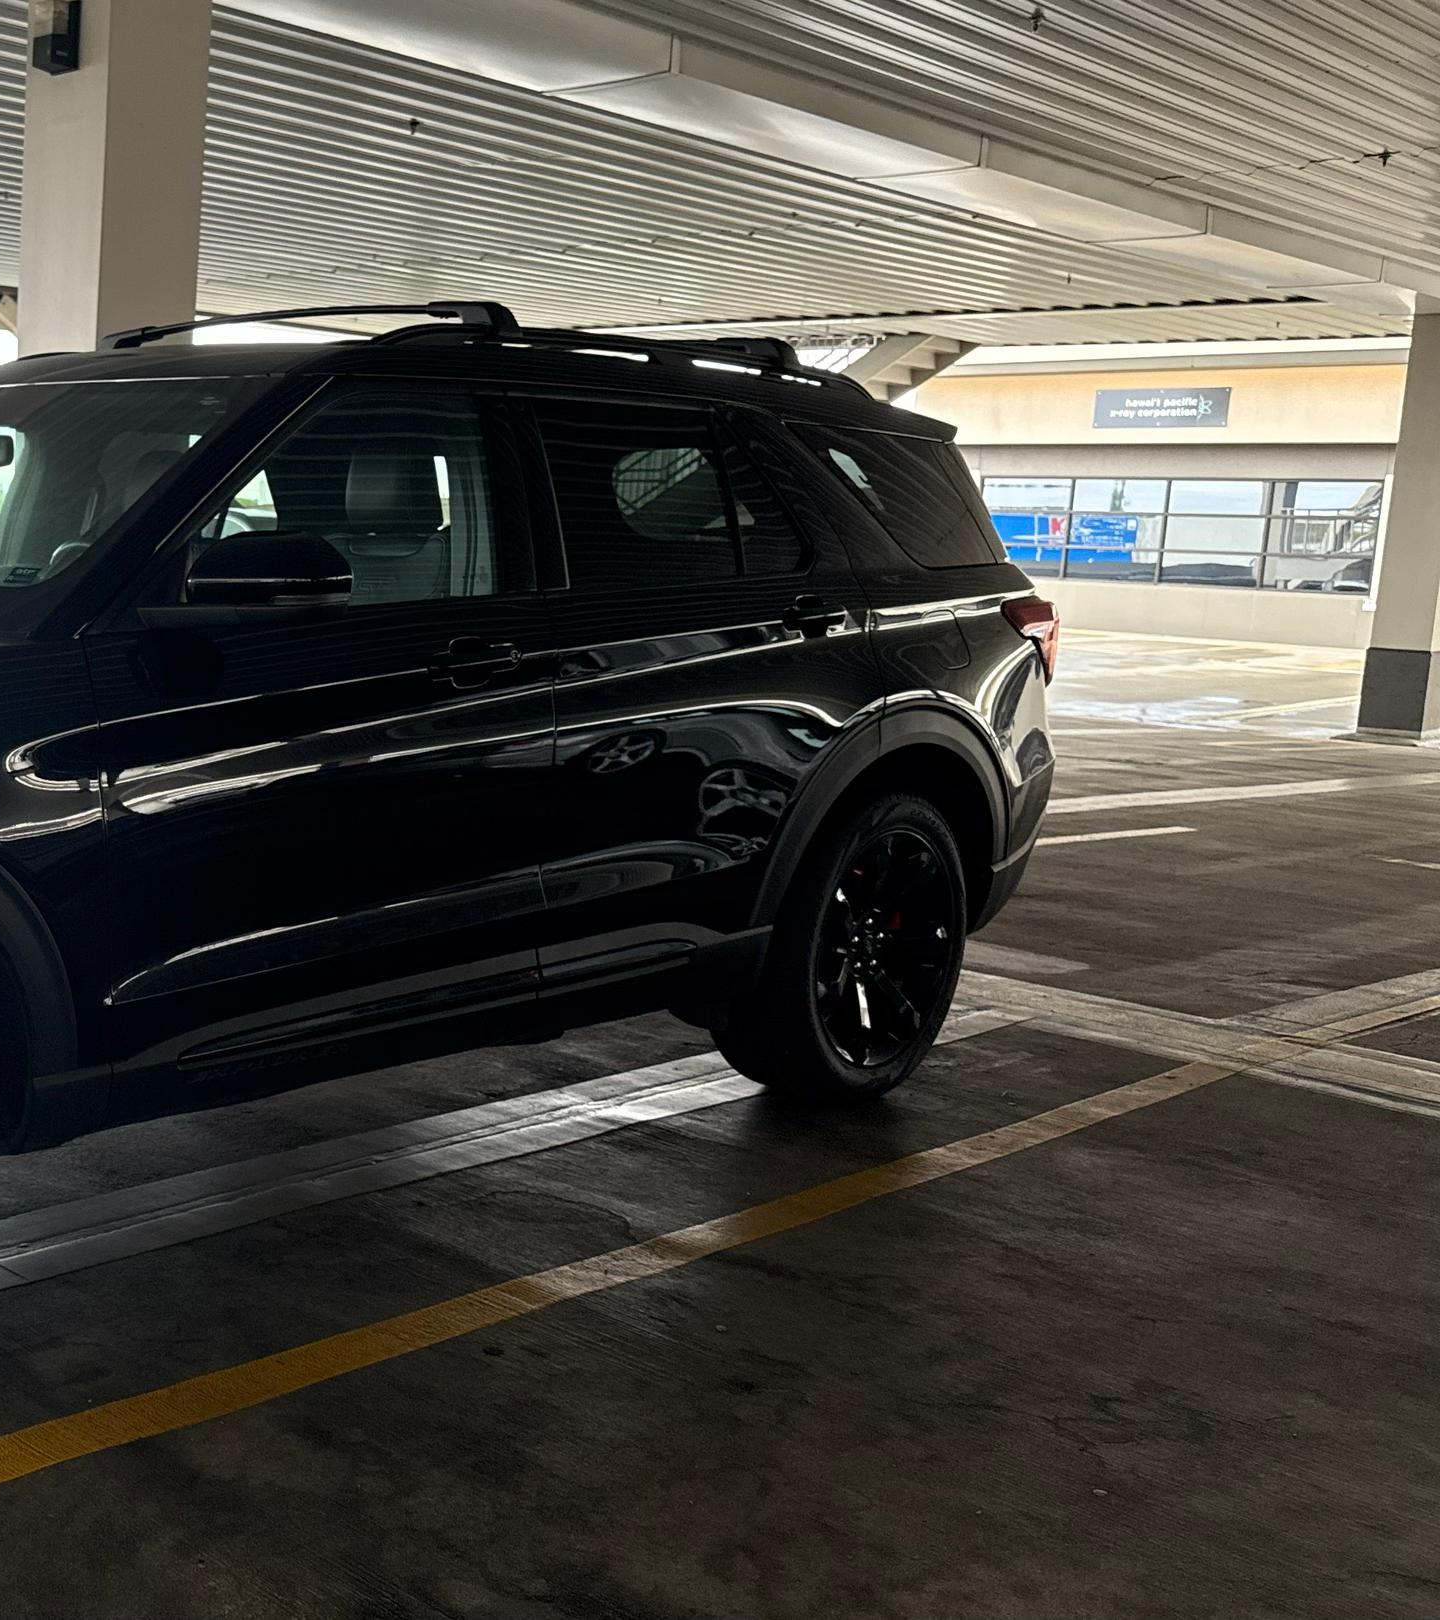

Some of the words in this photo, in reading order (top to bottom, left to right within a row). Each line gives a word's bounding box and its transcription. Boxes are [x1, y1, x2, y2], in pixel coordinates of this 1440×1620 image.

[1163, 397, 1198, 408] pacific
[1109, 409, 1136, 419] x-ray
[1137, 407, 1197, 418] corporation
